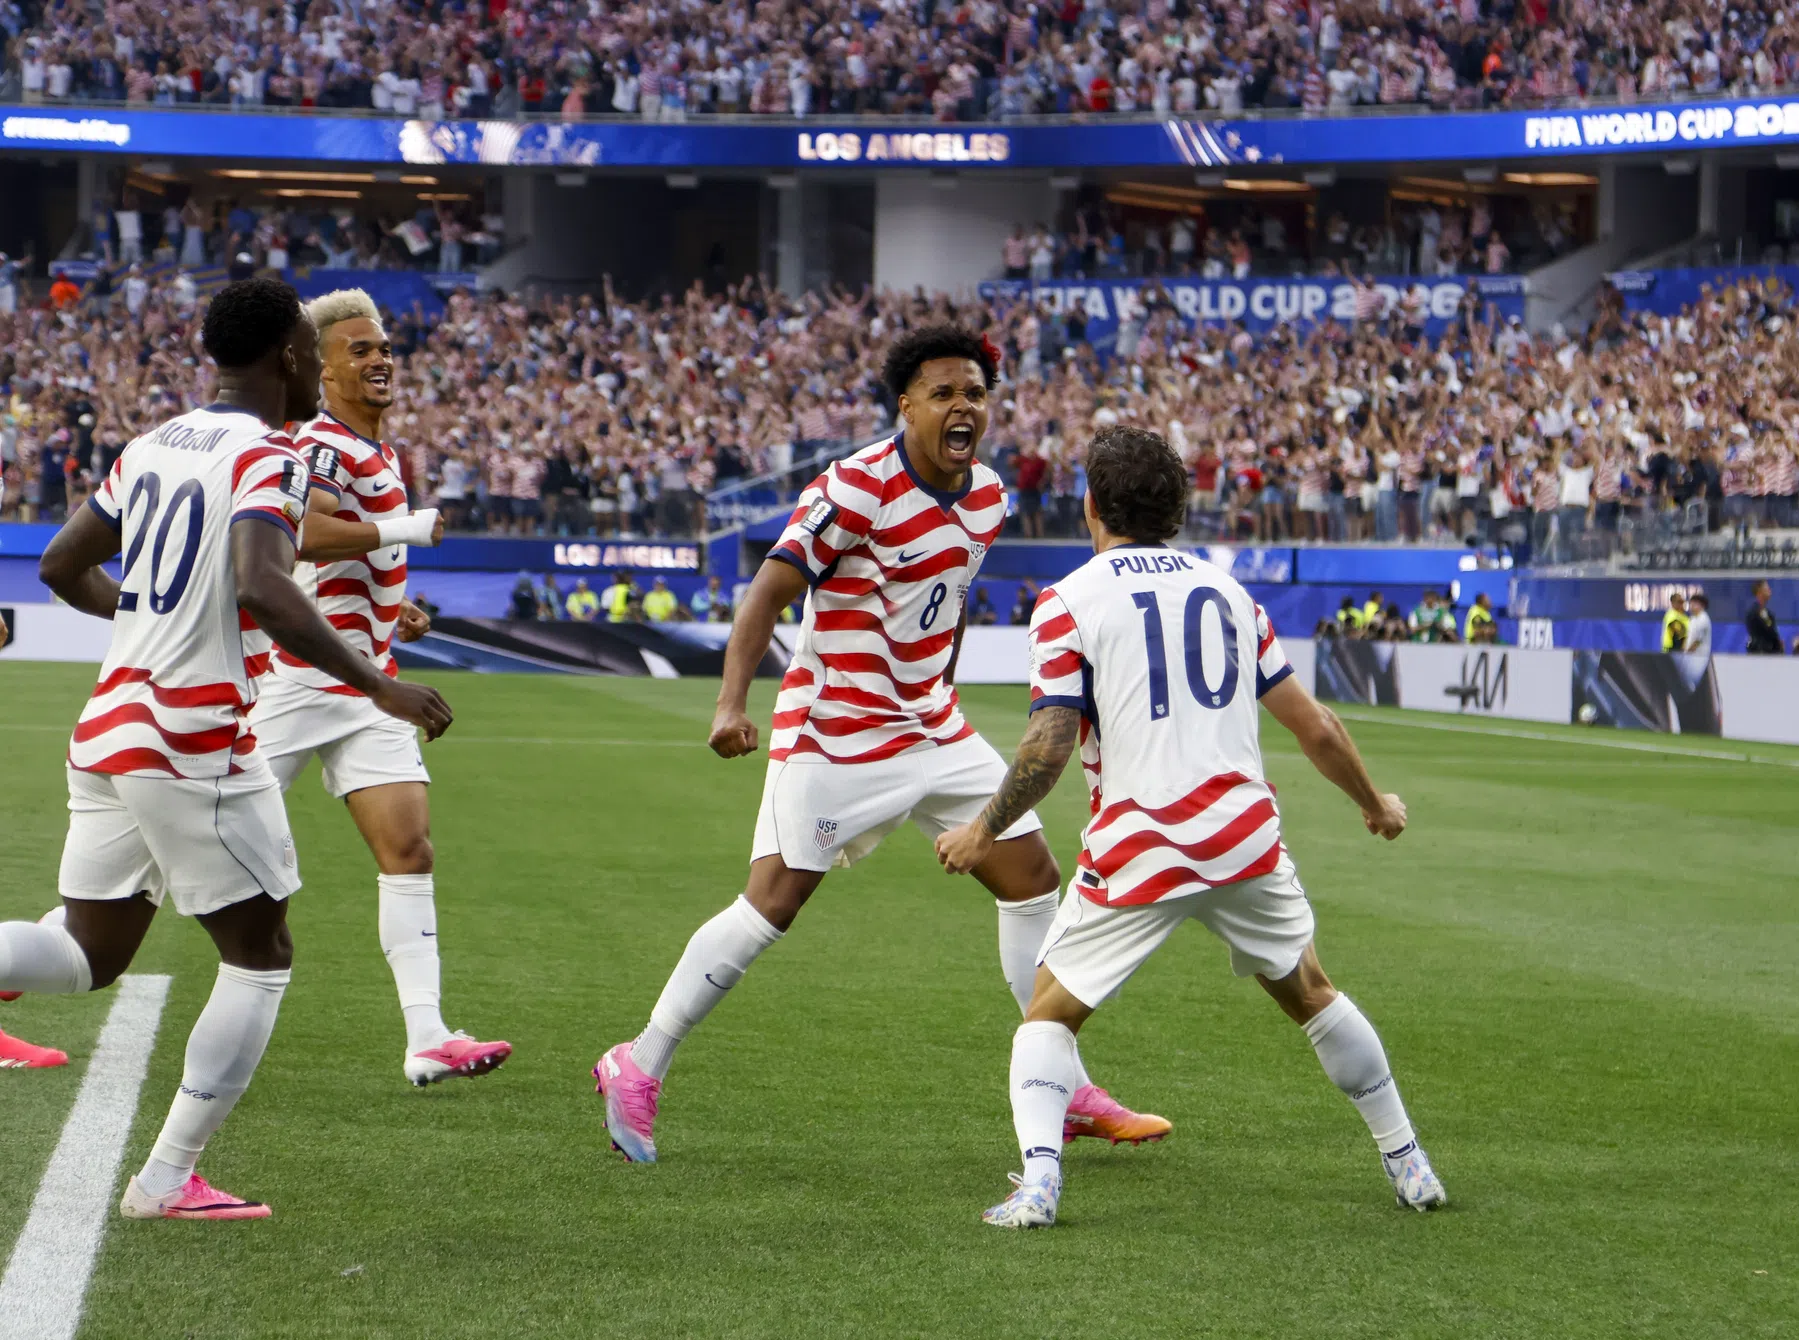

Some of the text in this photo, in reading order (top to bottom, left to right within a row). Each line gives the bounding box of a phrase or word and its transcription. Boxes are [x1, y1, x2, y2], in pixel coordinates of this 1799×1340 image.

[1525, 116, 1582, 148] FIFA
[1581, 110, 1677, 145] WORLD
[1677, 106, 1733, 140] CUP
[798, 132, 1010, 162] LOS ANGELES
[1250, 283, 1328, 320] CUP
[117, 471, 205, 615] 20
[554, 543, 699, 569] LOS ANGELES
[1109, 555, 1193, 577] PULISIC
[919, 582, 947, 631] 8
[1518, 618, 1554, 649] FIFA
[1131, 586, 1239, 721] 10
[818, 820, 838, 834] USA
